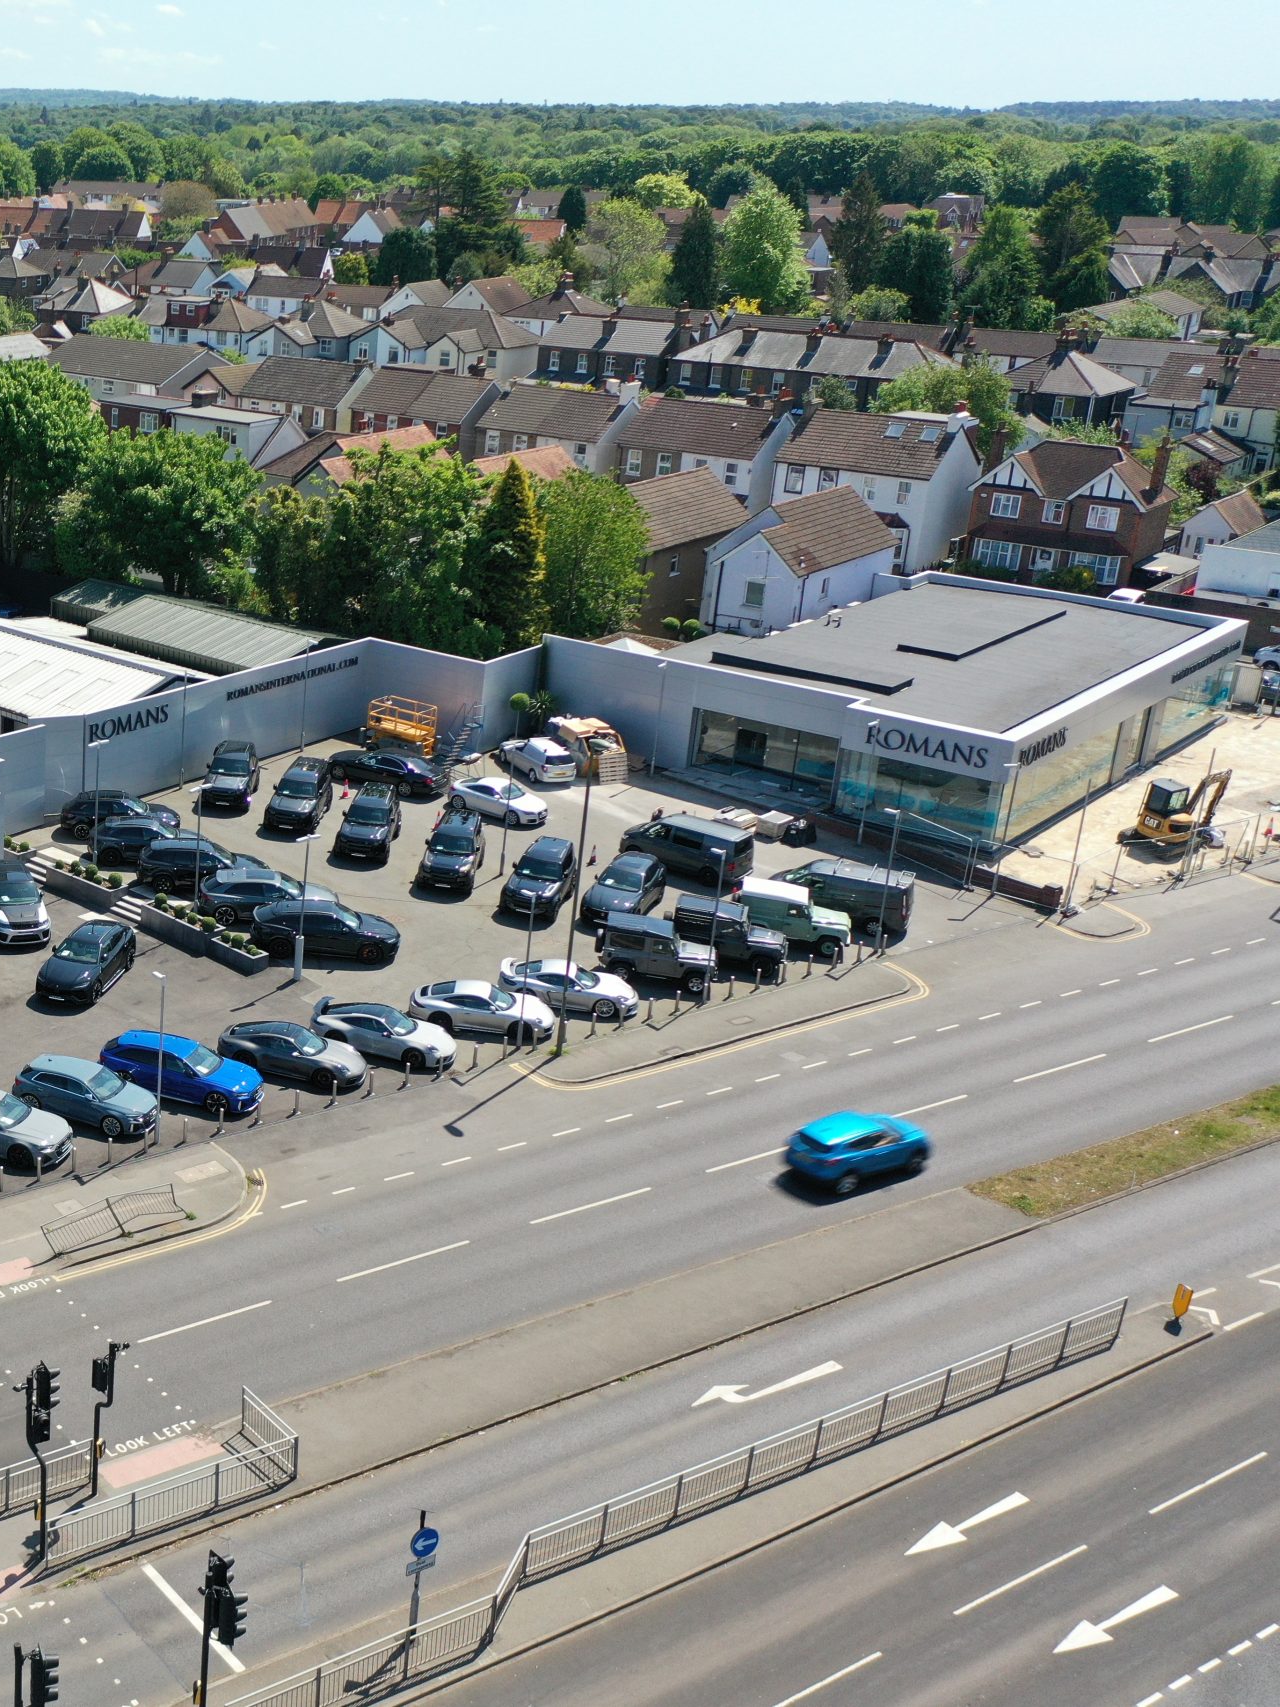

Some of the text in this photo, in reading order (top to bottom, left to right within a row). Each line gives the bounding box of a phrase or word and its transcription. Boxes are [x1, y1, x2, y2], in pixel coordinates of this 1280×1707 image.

[88, 704, 169, 743] ROMANS
[865, 725, 989, 769] ROMANS
[1018, 726, 1068, 769] ROMANS
[1144, 816, 1159, 828] CAT
[9, 1278, 48, 1295] LOOK
[104, 1421, 192, 1457] LOOK LEFT
